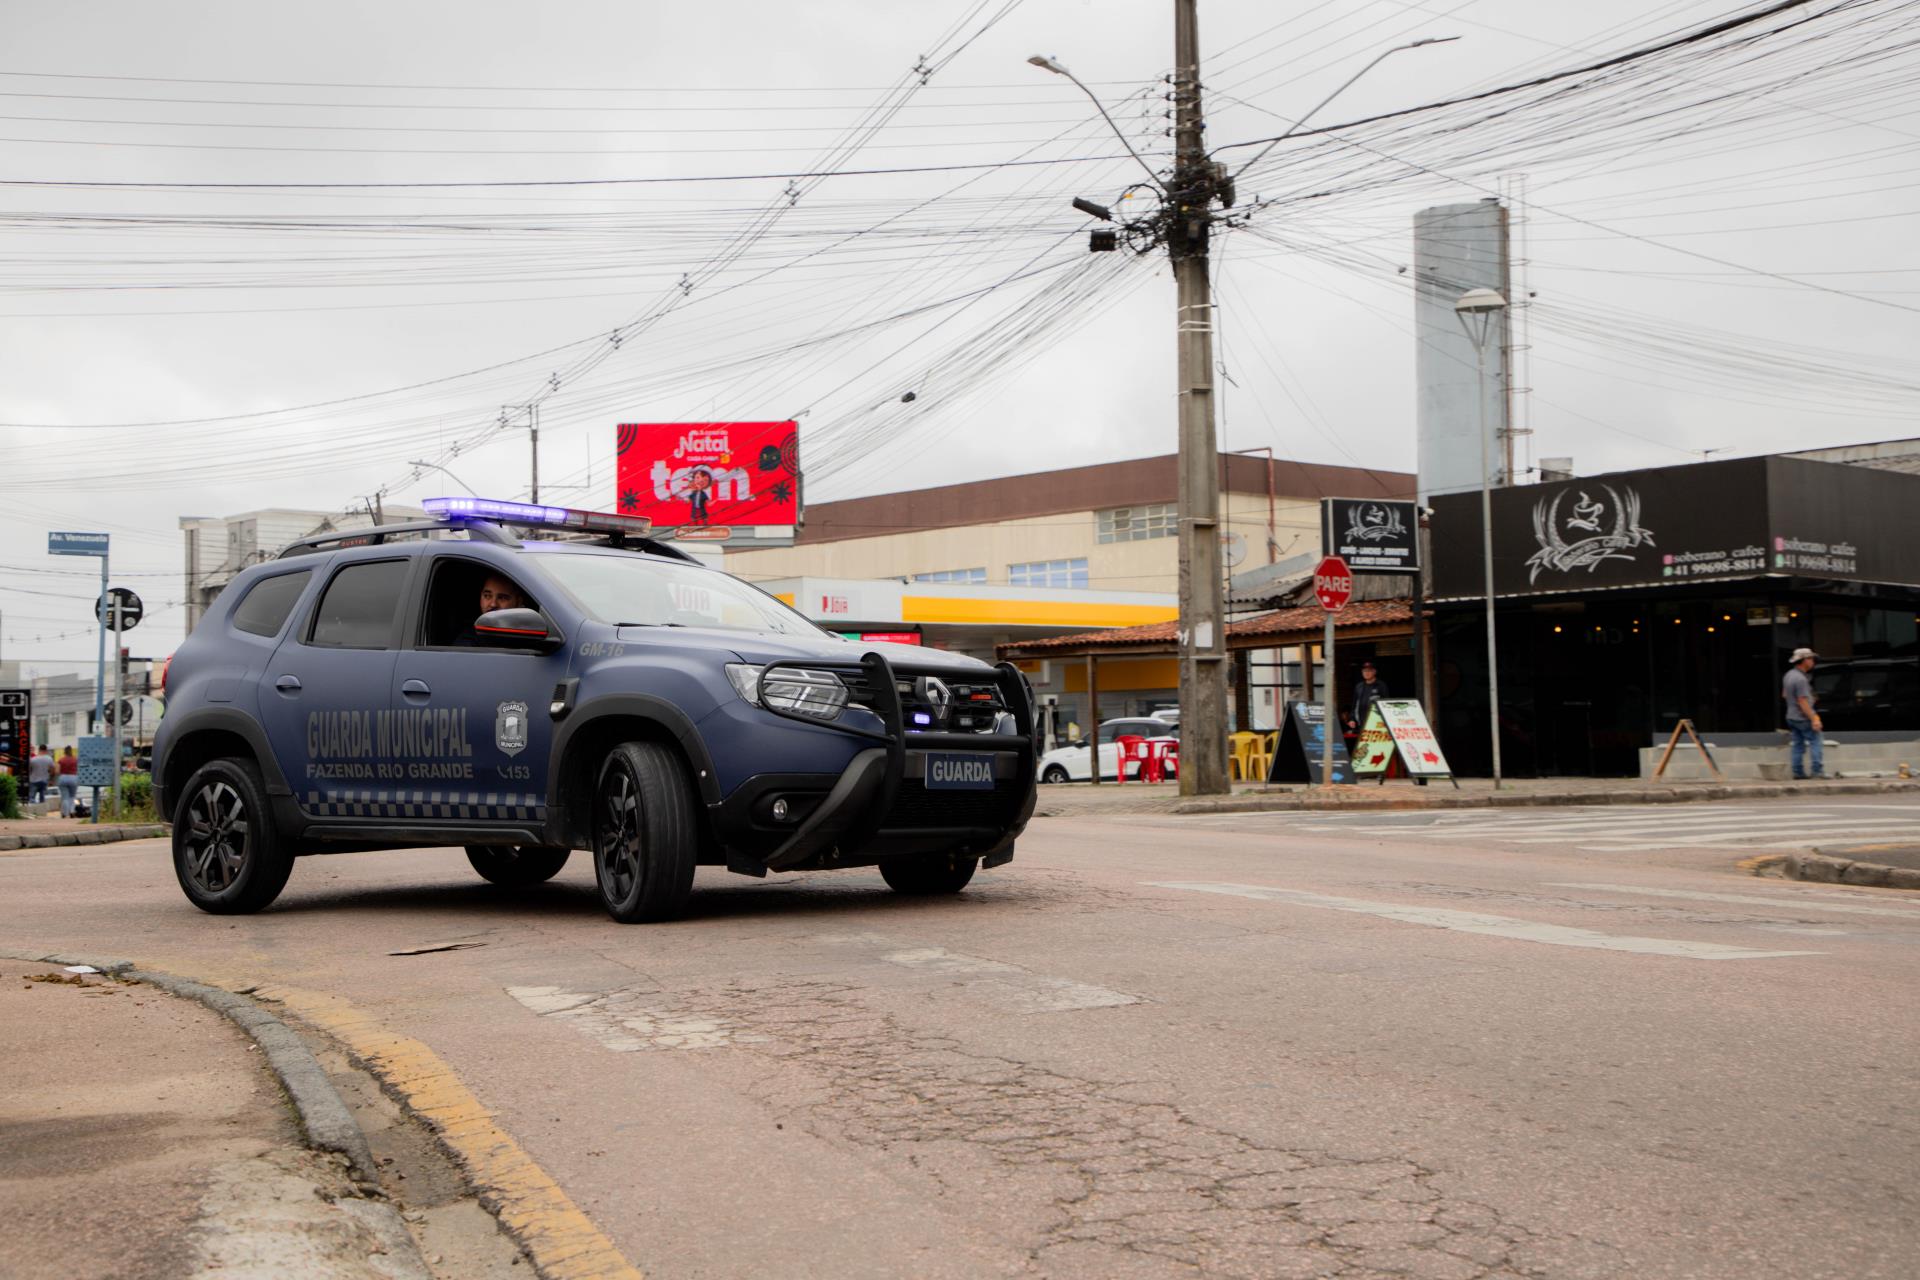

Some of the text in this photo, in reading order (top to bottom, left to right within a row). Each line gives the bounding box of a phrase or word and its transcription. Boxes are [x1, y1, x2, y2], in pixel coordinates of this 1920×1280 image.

[674, 430, 731, 458] Natal
[1317, 576, 1351, 592] PARE
[502, 703, 523, 713] GUARDA
[307, 708, 473, 759] GUARDA MUNICIPAL
[306, 763, 474, 779] FAZENDA RIO GRANDE
[507, 766, 530, 779] 153
[932, 760, 993, 782] GUARDA
